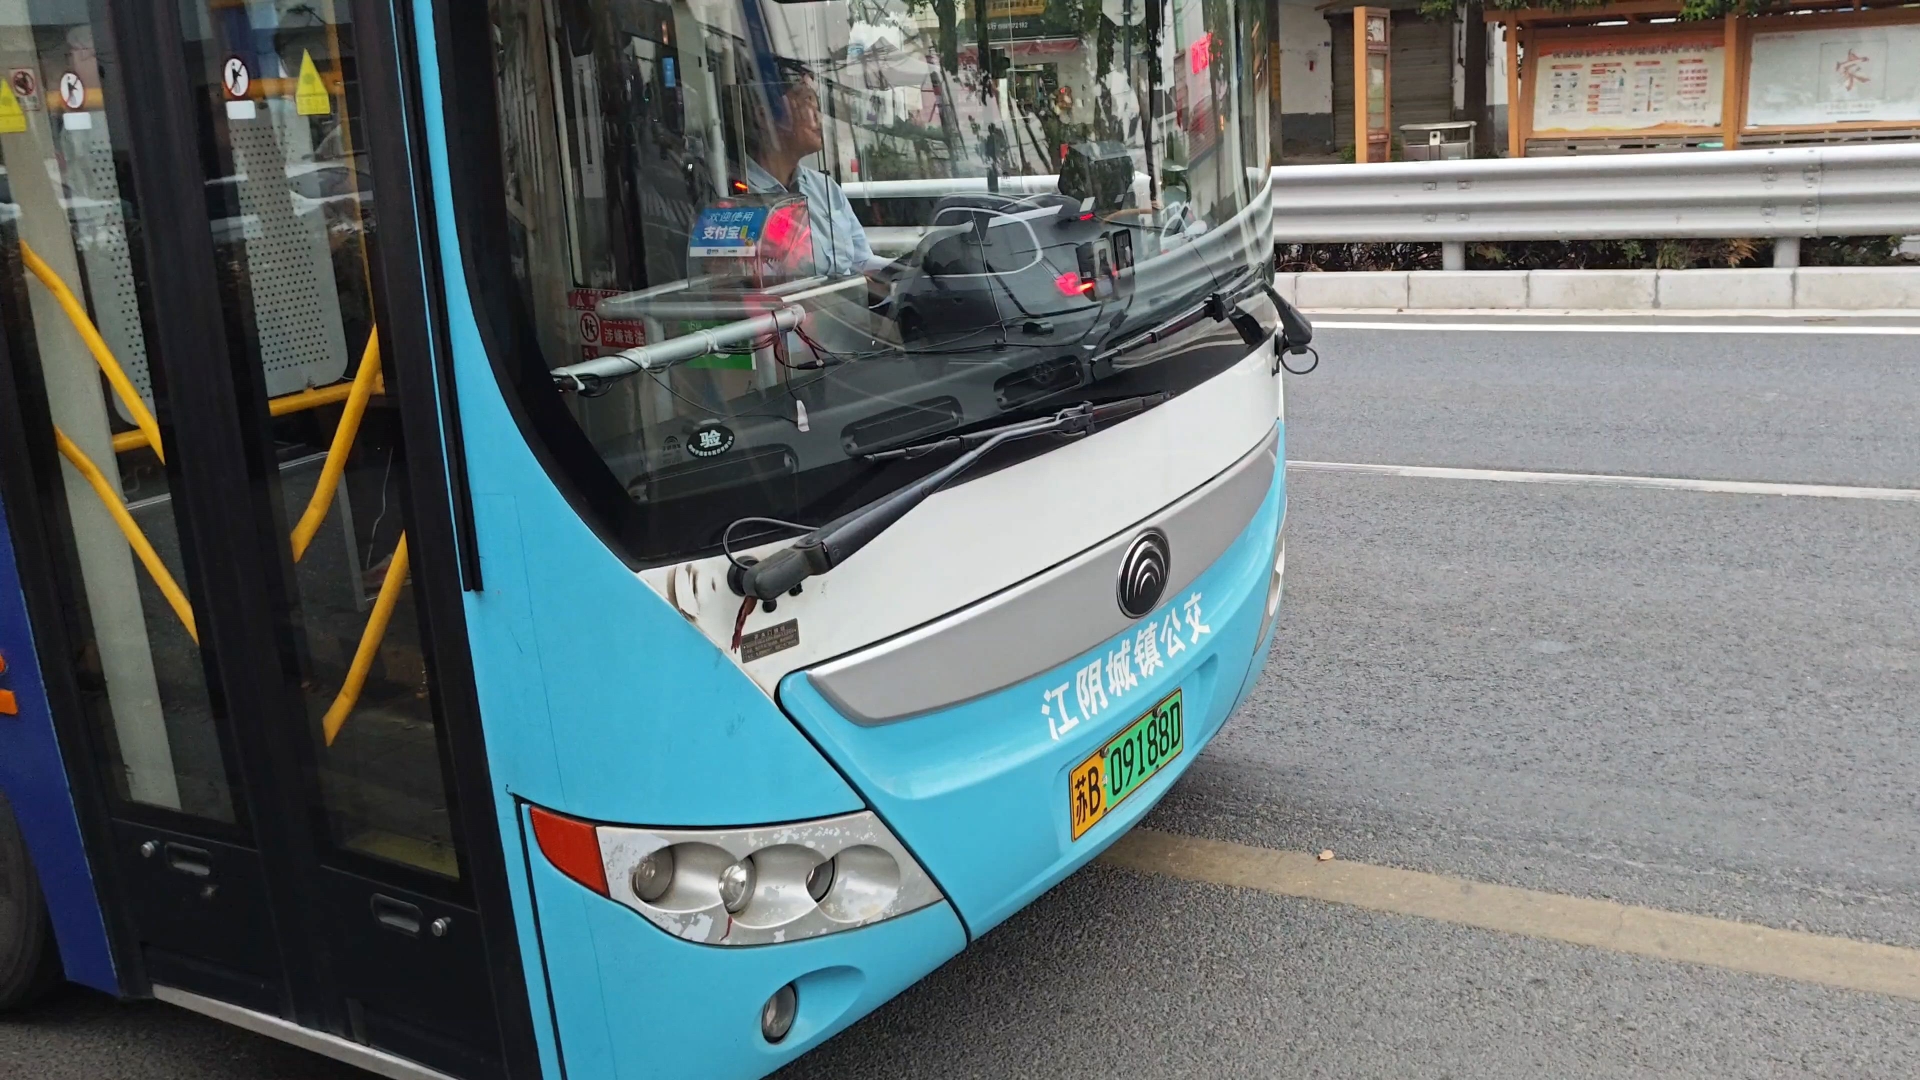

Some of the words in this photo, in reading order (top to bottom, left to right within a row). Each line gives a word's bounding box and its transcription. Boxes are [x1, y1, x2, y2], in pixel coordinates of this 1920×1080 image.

[1836, 49, 1871, 92] 家
[708, 211, 754, 222] 欢迎使用
[702, 225, 741, 240] 支付宝
[604, 328, 646, 346] 涉嫌违法
[699, 429, 722, 448] 验
[1041, 592, 1211, 741] 江阴城镇公交
